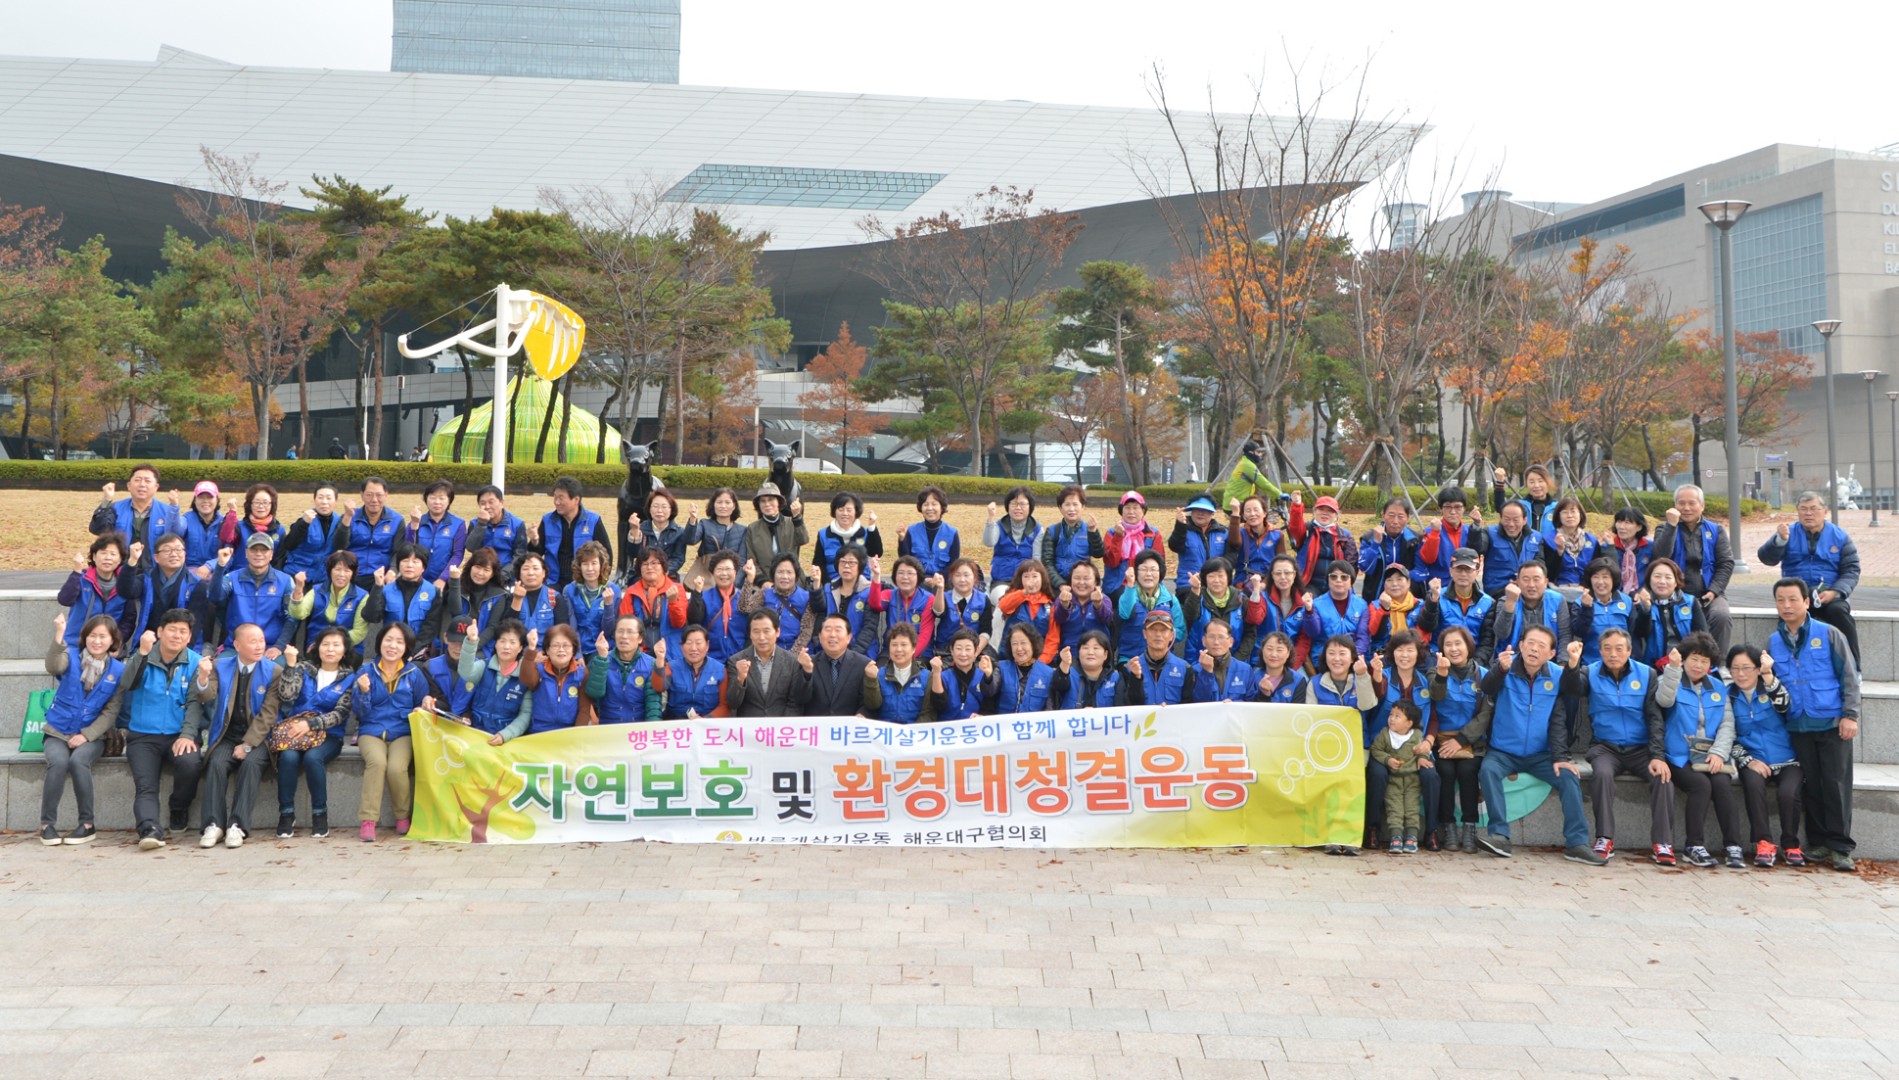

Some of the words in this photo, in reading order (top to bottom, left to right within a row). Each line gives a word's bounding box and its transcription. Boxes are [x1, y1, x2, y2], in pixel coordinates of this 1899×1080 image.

[628, 727, 693, 751] 행복한
[703, 727, 744, 748] 도시
[755, 726, 819, 748] 해운대
[831, 722, 1001, 747] 바르게살기운동이
[1012, 719, 1057, 741] 함께
[1067, 714, 1131, 738] 합니다
[512, 759, 754, 821] 자연보호
[772, 770, 814, 820] 및
[833, 745, 1255, 820] 환경대청결운동
[904, 824, 1047, 845] 해운대구협의회
